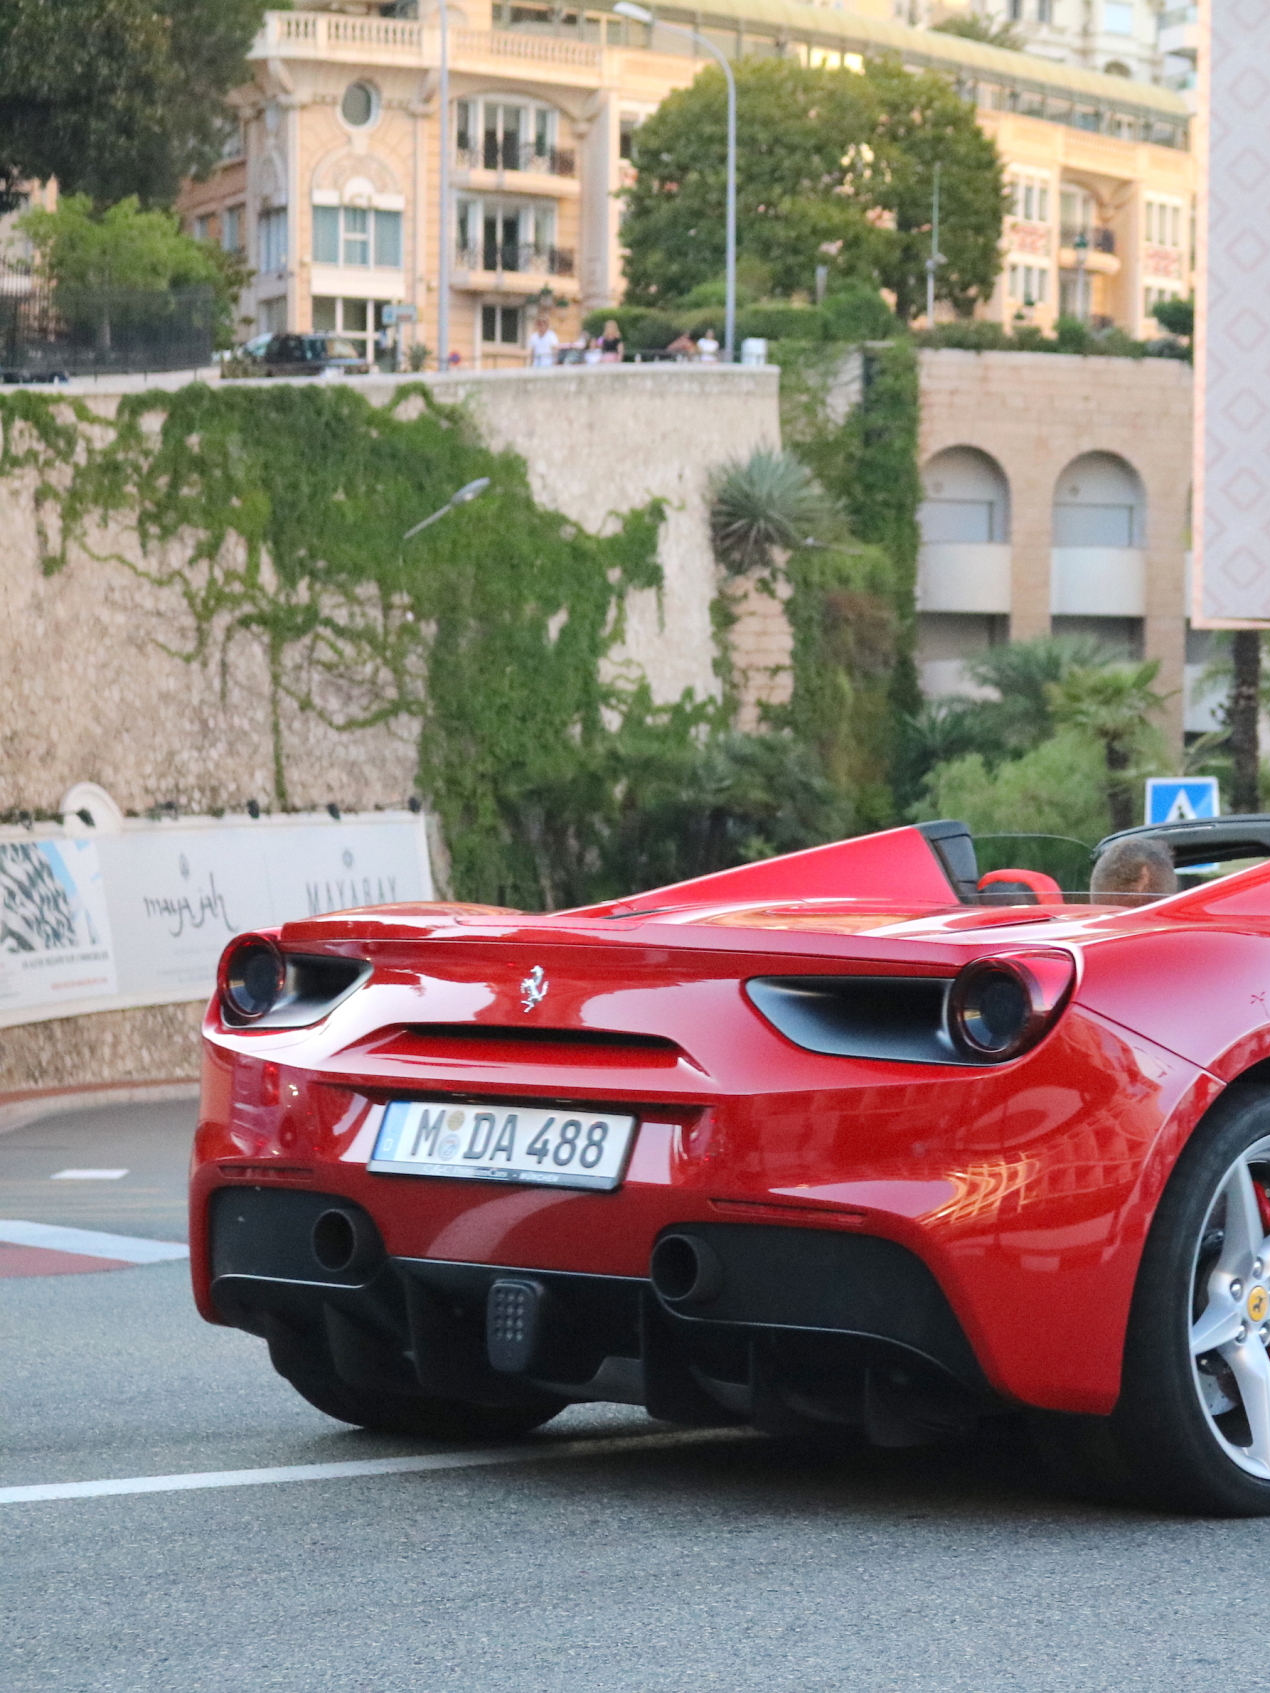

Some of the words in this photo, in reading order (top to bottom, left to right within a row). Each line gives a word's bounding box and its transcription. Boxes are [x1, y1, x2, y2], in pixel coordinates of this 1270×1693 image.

[411, 1109, 446, 1157] M
[463, 1112, 519, 1162] DA
[526, 1116, 610, 1169] 488
